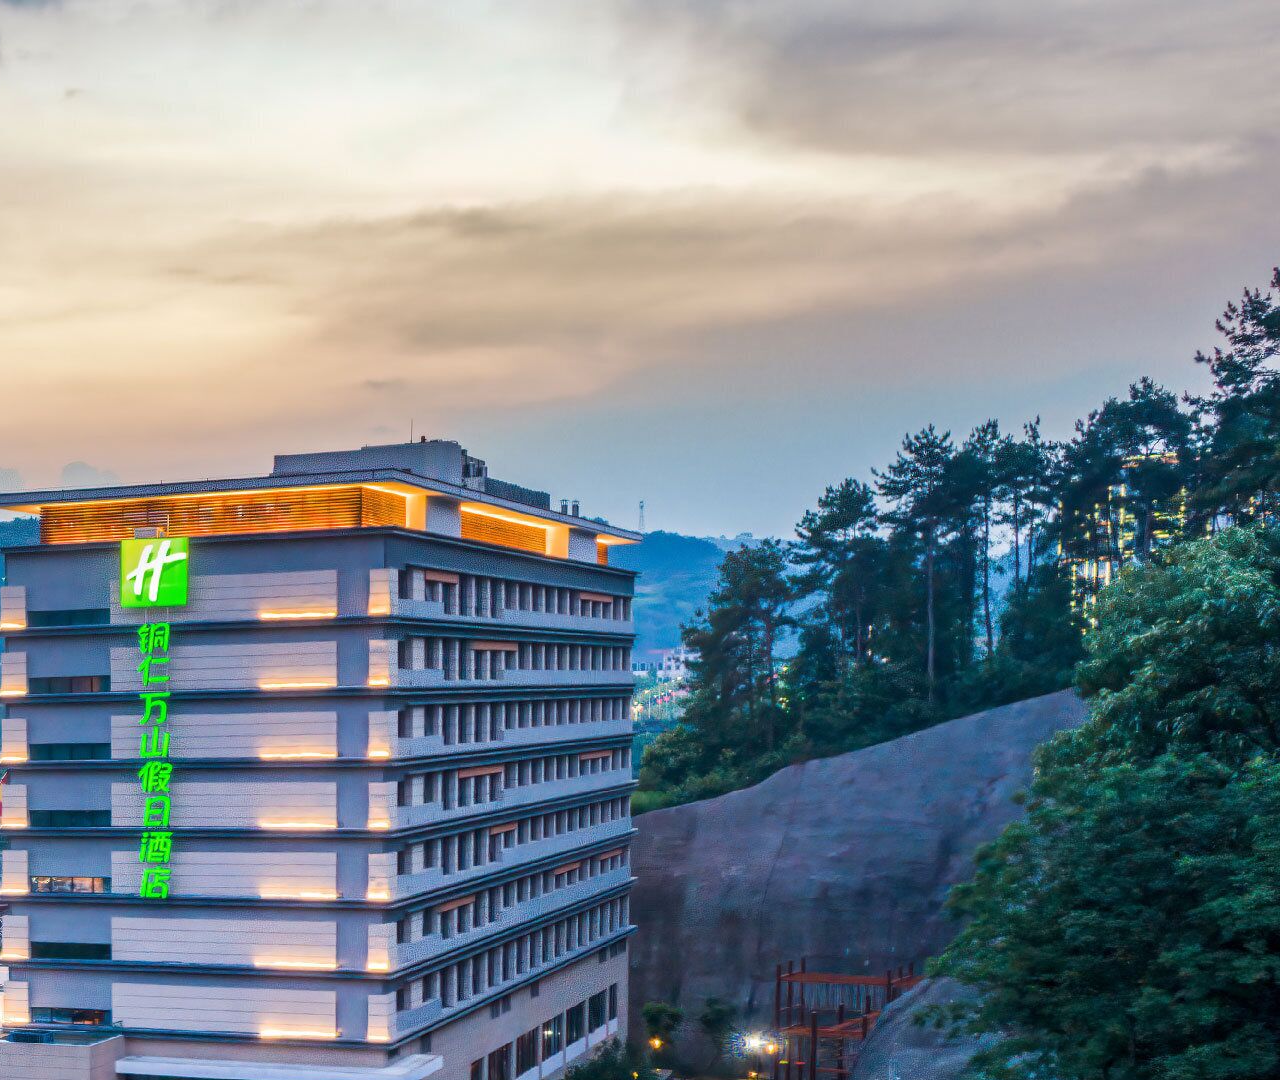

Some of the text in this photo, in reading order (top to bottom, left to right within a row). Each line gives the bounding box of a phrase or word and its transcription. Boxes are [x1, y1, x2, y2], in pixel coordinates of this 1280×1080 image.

[138, 622, 173, 899] 铜仁万山假日酒店
